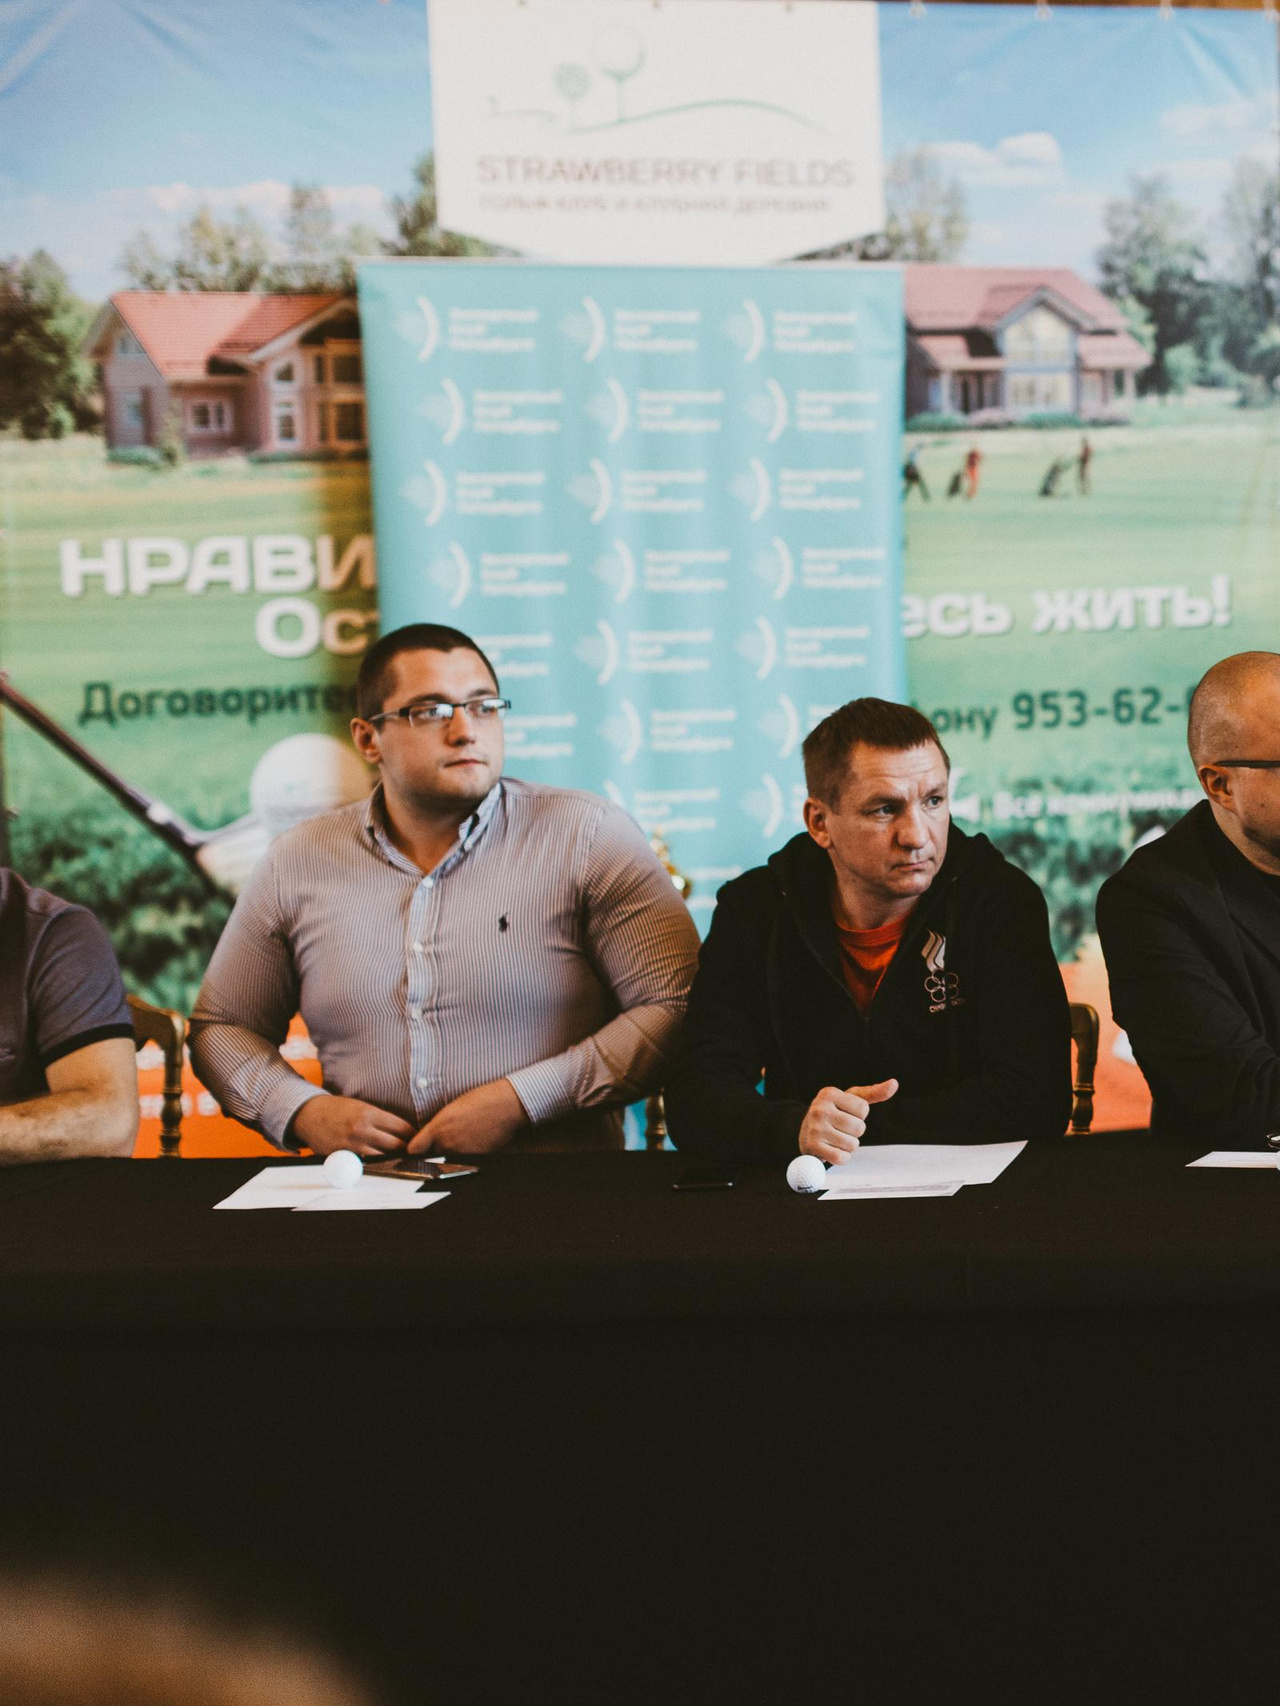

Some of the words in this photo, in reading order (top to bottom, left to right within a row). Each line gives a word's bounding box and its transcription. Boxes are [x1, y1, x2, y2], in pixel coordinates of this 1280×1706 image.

[476, 154, 722, 187] STRAWBERRY
[734, 157, 855, 189] FIELDS
[59, 533, 377, 598] НРАВИ
[902, 584, 1012, 638] есь
[1030, 574, 1233, 634] жить!
[78, 681, 358, 727] Договорите
[911, 700, 999, 742] ону
[1011, 684, 1195, 731] 953-62-
